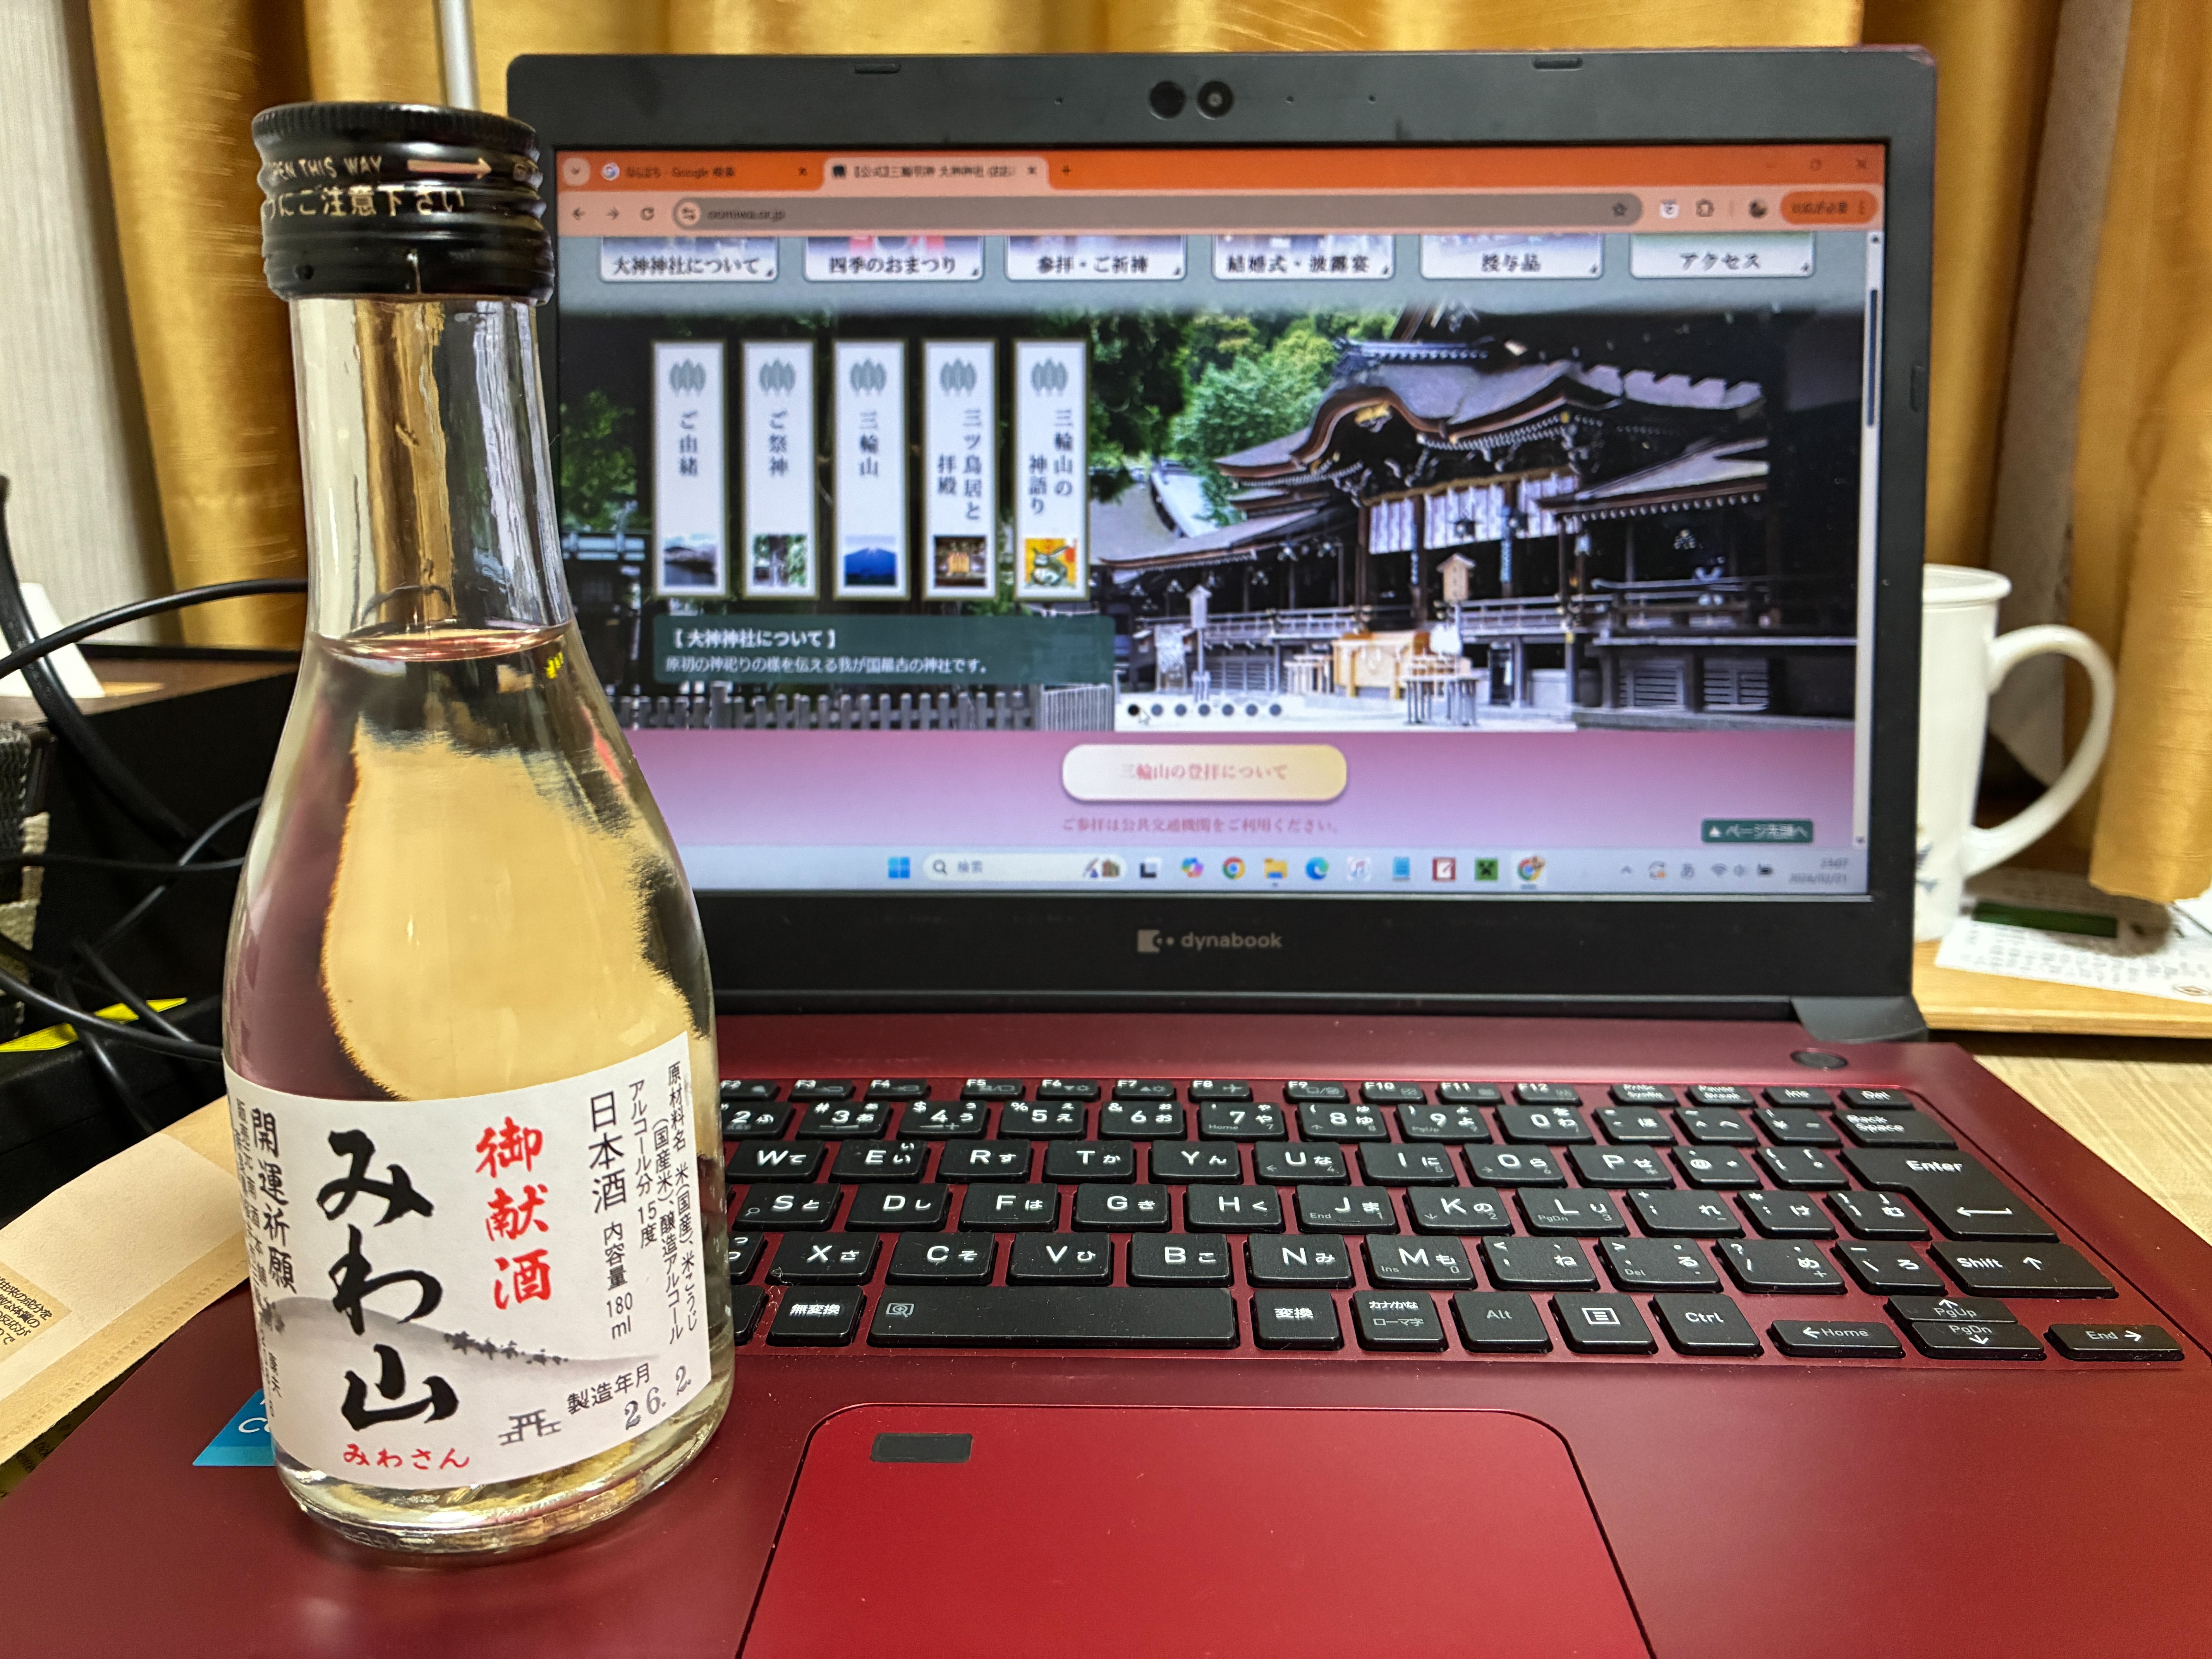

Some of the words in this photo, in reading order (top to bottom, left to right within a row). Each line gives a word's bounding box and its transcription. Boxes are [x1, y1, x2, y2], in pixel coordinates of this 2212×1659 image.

[298, 156, 338, 179] THIS
[343, 155, 382, 175] WAY
[614, 255, 759, 275] 大神神社について
[829, 256, 955, 274] 四季のおまつり
[1680, 252, 1760, 270] アクセス
[679, 411, 698, 476] ご由緒
[769, 410, 788, 475] ご祭神
[859, 410, 879, 476] 三輪山
[1053, 408, 1073, 496] 三輪山の
[1180, 932, 1282, 951] dynabook
[871, 1079, 891, 1088] F4
[966, 1079, 986, 1088] F5
[1042, 1079, 1062, 1087] F6
[1117, 1079, 1137, 1088] F7
[1192, 1080, 1213, 1088] F8
[1288, 1080, 1308, 1089] F9
[665, 1061, 687, 1153] 原材料名
[731, 1110, 751, 1125] 2
[831, 1109, 850, 1123] 3
[930, 1109, 948, 1123] 4
[1031, 1109, 1048, 1123] 5
[1056, 1113, 1073, 1122] え
[1130, 1110, 1147, 1123] 6
[1155, 1114, 1173, 1123] お
[1229, 1111, 1246, 1124] 7
[1255, 1115, 1273, 1124] や
[1329, 1112, 1348, 1125] 8
[1429, 1113, 1447, 1127] 9
[1530, 1113, 1551, 1128] 0
[629, 1079, 656, 1197] アルコール分
[588, 1091, 627, 1214] 日本酒
[758, 1150, 789, 1165] W
[789, 1154, 807, 1164] て
[865, 1149, 887, 1164] E
[893, 1154, 911, 1164] い
[969, 1149, 991, 1164] R
[999, 1153, 1017, 1163] す
[1076, 1150, 1096, 1164] T
[1103, 1154, 1121, 1164] か
[1181, 1151, 1200, 1165] Y
[1209, 1155, 1227, 1165] ん
[1285, 1151, 1307, 1166] U
[1313, 1156, 1333, 1166] な
[1421, 1156, 1440, 1167] に
[1497, 1154, 1521, 1168] O
[1529, 1158, 1547, 1168] ら
[1602, 1154, 1625, 1170] P
[1905, 1160, 1963, 1172] Enter
[251, 1107, 297, 1295] 開運祈願
[772, 1195, 795, 1211] S
[802, 1199, 820, 1210] と
[883, 1195, 906, 1211] D
[915, 1199, 931, 1210] し
[996, 1195, 1017, 1211] F
[1024, 1199, 1043, 1211] は
[1106, 1195, 1128, 1211] G
[1137, 1200, 1156, 1211] き
[1218, 1196, 1240, 1212] H
[1334, 1197, 1351, 1214] J
[1362, 1201, 1380, 1213] ま
[1440, 1197, 1467, 1214] K
[1473, 1202, 1494, 1213] の
[1554, 1199, 1580, 1215] L
[1589, 1203, 1607, 1214] り
[475, 1115, 551, 1310] 御献酒
[1537, 1212, 1571, 1223] PgDn
[1698, 1204, 1721, 1216] れ
[1790, 1205, 1810, 1217] け
[637, 1200, 658, 1249] 15度
[603, 1221, 628, 1291] 内容量
[807, 1245, 833, 1262] X
[840, 1250, 860, 1262] さ
[926, 1245, 950, 1264] C
[958, 1250, 978, 1262] そ
[1046, 1245, 1068, 1263] V
[1077, 1250, 1096, 1262] ひ
[1164, 1246, 1187, 1264] B
[1198, 1252, 1216, 1263] こ
[1281, 1247, 1307, 1266] N
[1315, 1252, 1335, 1264] み
[1398, 1247, 1430, 1267] M
[1435, 1254, 1457, 1265] も
[1553, 1255, 1578, 1268] ね
[1678, 1256, 1699, 1267] る
[1797, 1257, 1820, 1269] め
[1897, 1259, 1920, 1270] ろ
[1956, 1257, 2003, 1268] Shift
[316, 1128, 460, 1432] みわ山
[606, 1291, 633, 1321] 180
[789, 1303, 841, 1316] 無変換
[1369, 1300, 1419, 1310] カナ/かな
[1274, 1307, 1314, 1320] 変換
[1486, 1309, 1513, 1319] Alt
[1685, 1312, 1724, 1323] Ctrl
[1933, 1309, 1978, 1320] PgUp
[609, 1313, 632, 1340] ml
[1372, 1317, 1424, 1327] ローマ字
[1820, 1328, 1869, 1337] Home
[1948, 1324, 1993, 1338] PgDn
[2085, 1331, 2119, 1340] End
[567, 1362, 651, 1415] 製造年月
[622, 1384, 668, 1434] 26.
[342, 1443, 471, 1470] みわさん
